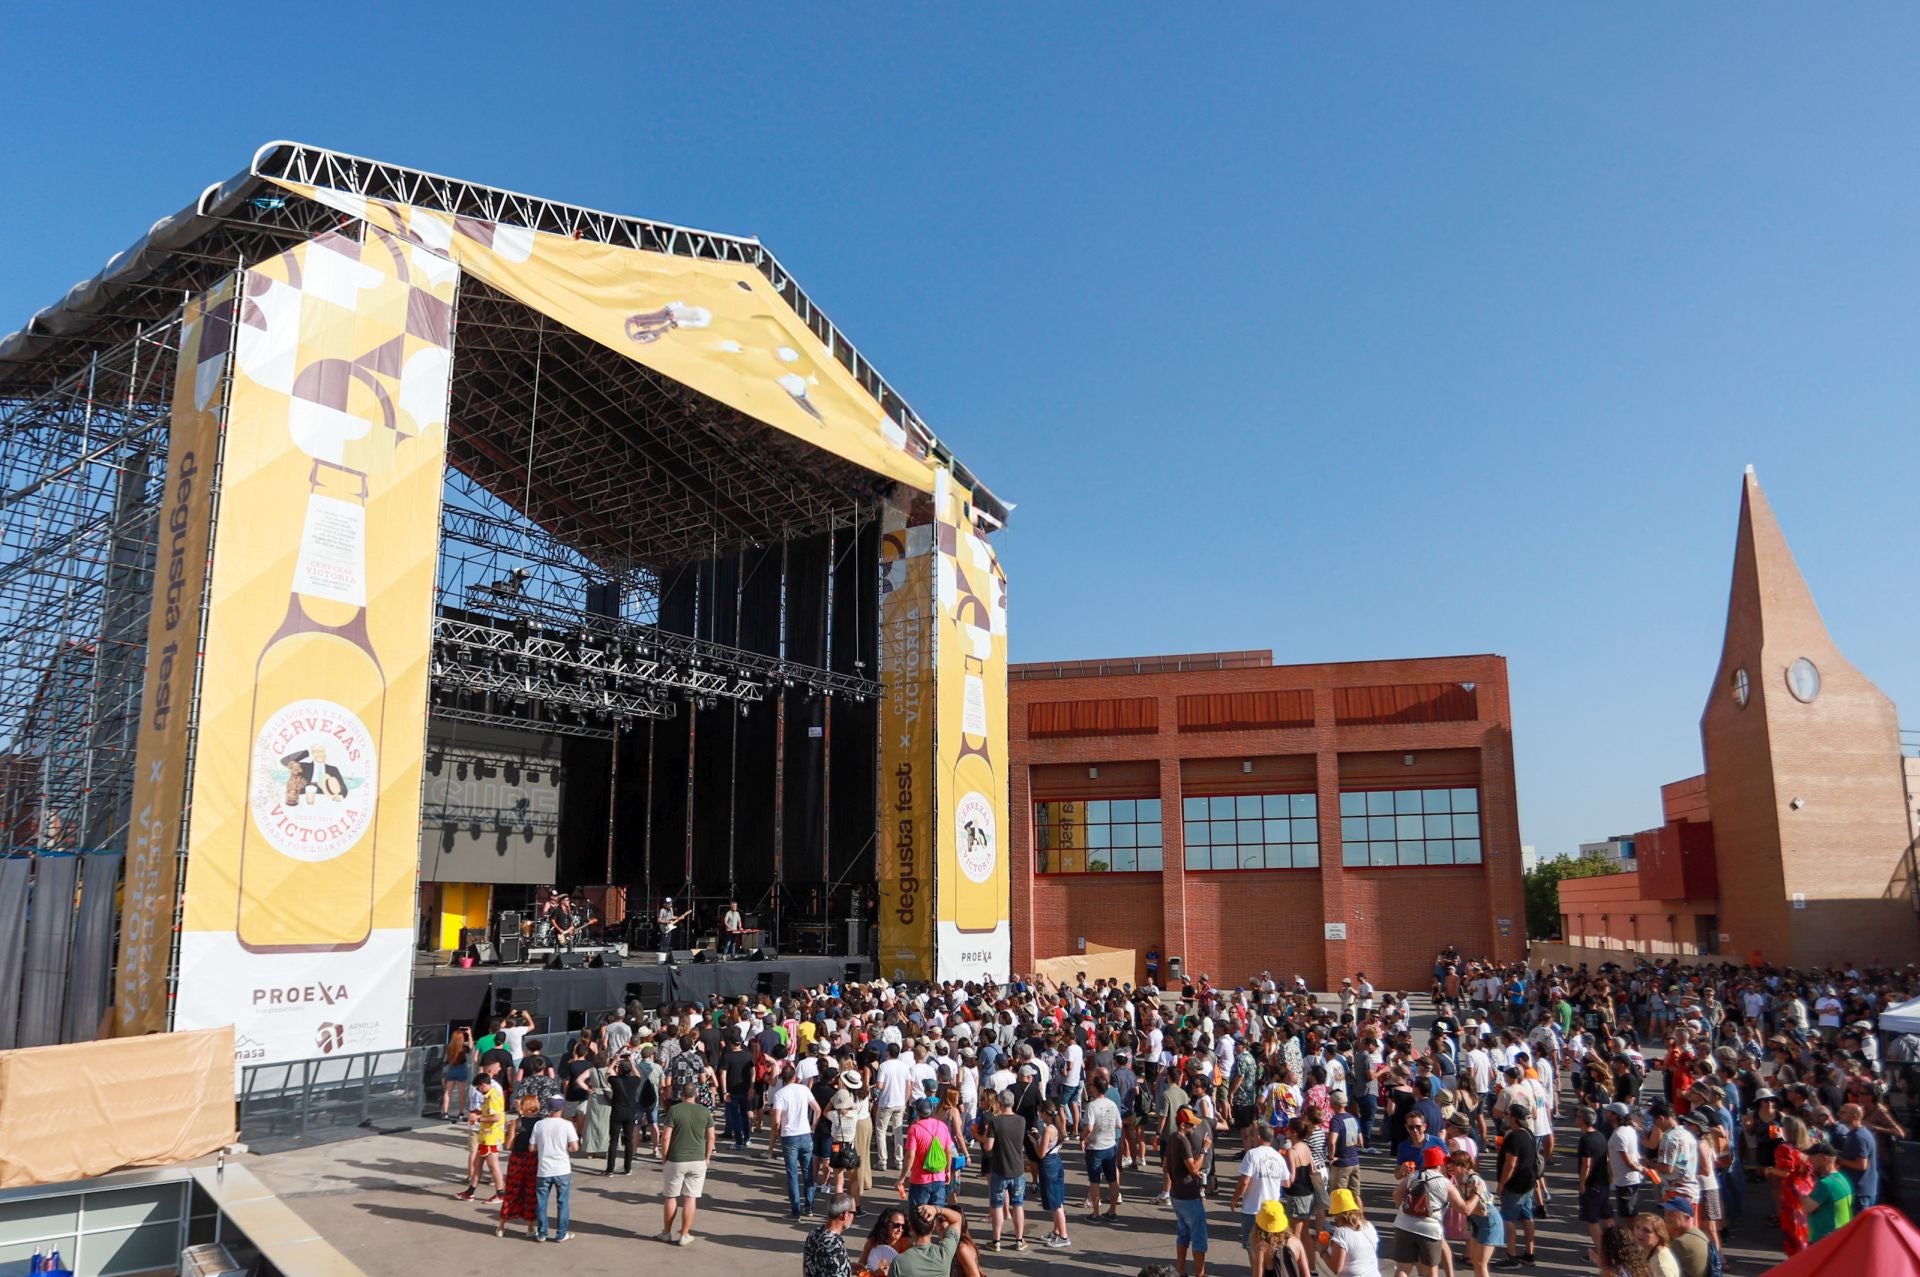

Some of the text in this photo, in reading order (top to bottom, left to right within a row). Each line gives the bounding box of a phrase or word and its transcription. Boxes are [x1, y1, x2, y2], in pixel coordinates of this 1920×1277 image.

[165, 450, 197, 632] degusta
[305, 566, 357, 584] VICTORIA
[153, 639, 179, 732] fest
[894, 616, 906, 715] CERVEZAS
[905, 606, 920, 724] VICTORIA
[272, 717, 361, 762] CERVEZAS
[270, 803, 359, 843] VICTORIA
[961, 801, 991, 827] CERVEZAS
[895, 761, 919, 926] degusta fest
[963, 848, 992, 873] VICTORIA
[124, 802, 152, 1027] VICTORIA
[138, 819, 163, 1013] CERVEZAS
[961, 949, 992, 963] PROEXA
[252, 981, 349, 1005] PROEXA
[233, 1048, 265, 1060] nasa
